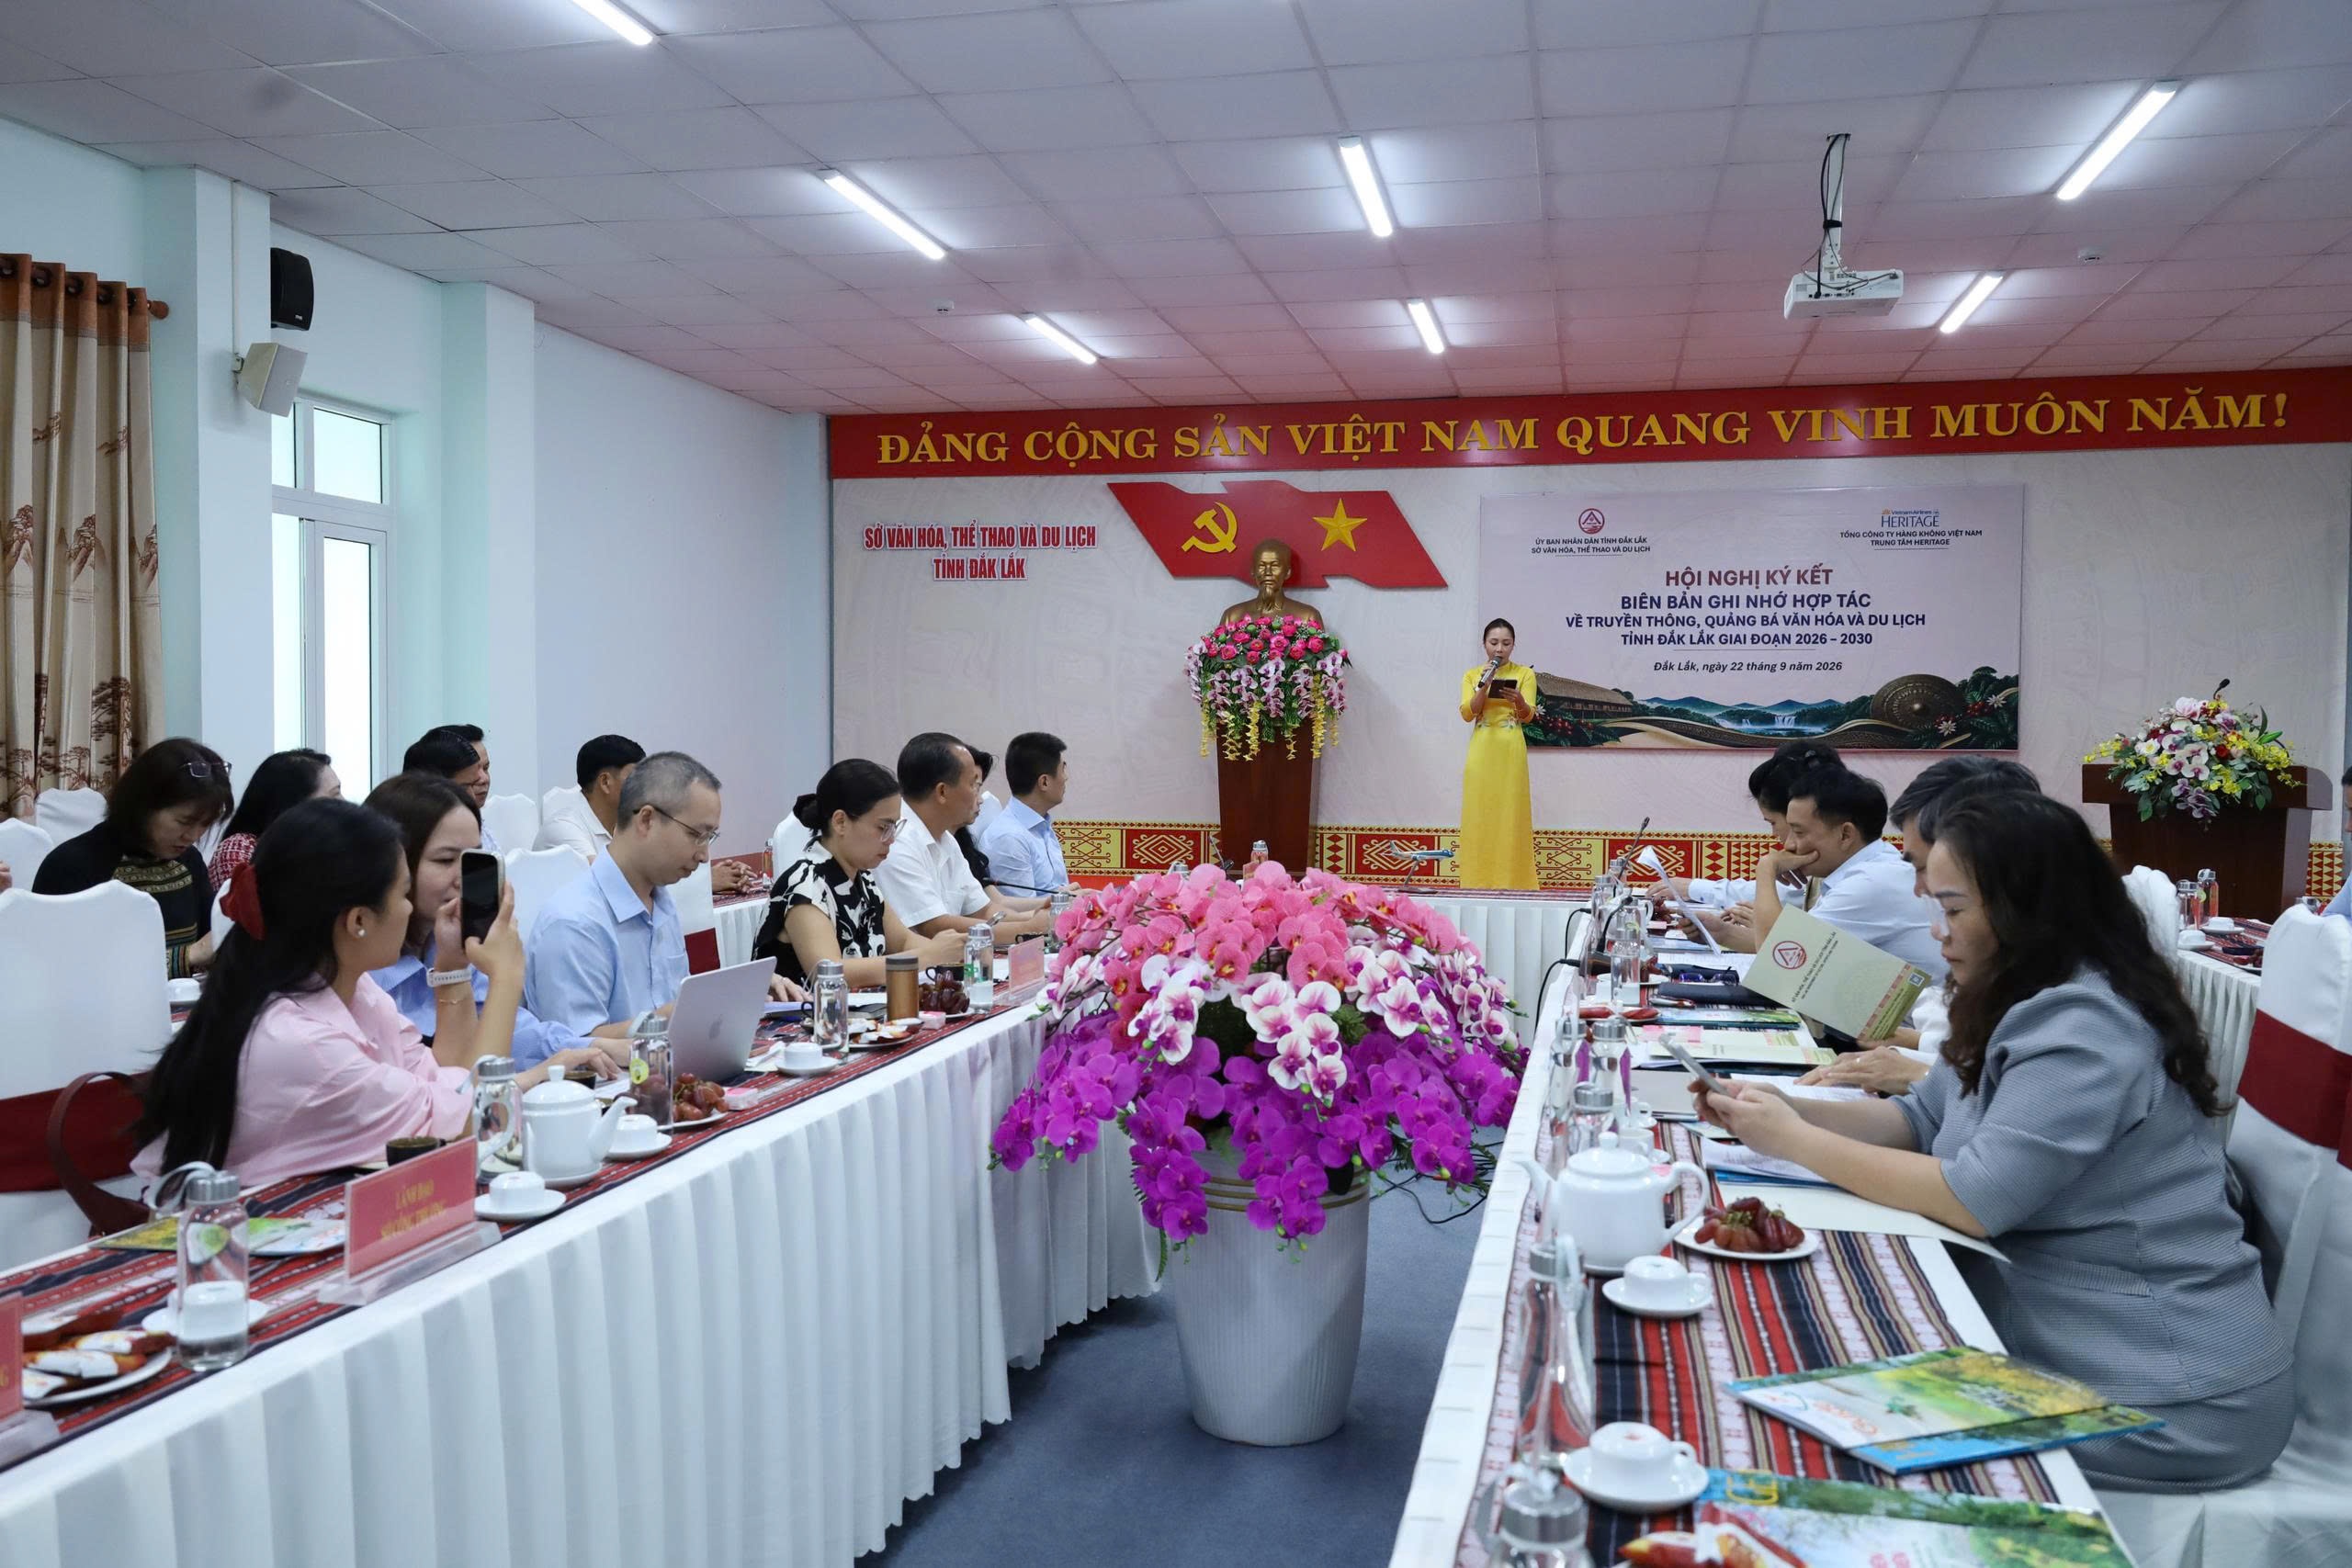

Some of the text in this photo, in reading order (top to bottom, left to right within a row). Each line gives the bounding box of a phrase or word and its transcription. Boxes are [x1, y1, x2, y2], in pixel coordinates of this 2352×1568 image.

[877, 386, 2288, 468] ĐẢNG CỘNG SẢN VIỆT NAM QUANG VINH MUÔN NĂM!
[1882, 515, 1939, 527] HERITAGE
[865, 519, 1096, 552] SỞ VĂN HÓA, THỂ THAO VÀ DU LỊCH
[1948, 529, 1963, 538] VIỆT
[933, 552, 1026, 579] TỈNH ĐẮK LẮK
[1666, 563, 1833, 590] HỘI NGHỊ KÝ KẾT
[1622, 591, 1871, 611] BIÊN BẢN GHI NHỚ HỢP TÁC
[1566, 612, 1925, 628] VỀ TRUYỀN THÔNG, QUẢNG BÁ VĂN HÓA VÀ DU LỊCH
[1622, 631, 1653, 645] TỈNH
[1657, 630, 1685, 645] ĐẮK
[1690, 630, 1714, 645] LẮK
[1719, 634, 1747, 644] GIAI
[1750, 634, 1791, 647] ĐOẠN
[1795, 634, 1826, 644] 2026
[1840, 633, 1872, 644] 2030
[1654, 660, 1842, 672] Đắk Lắk, ngày 22 tháng 9 năm 2026
